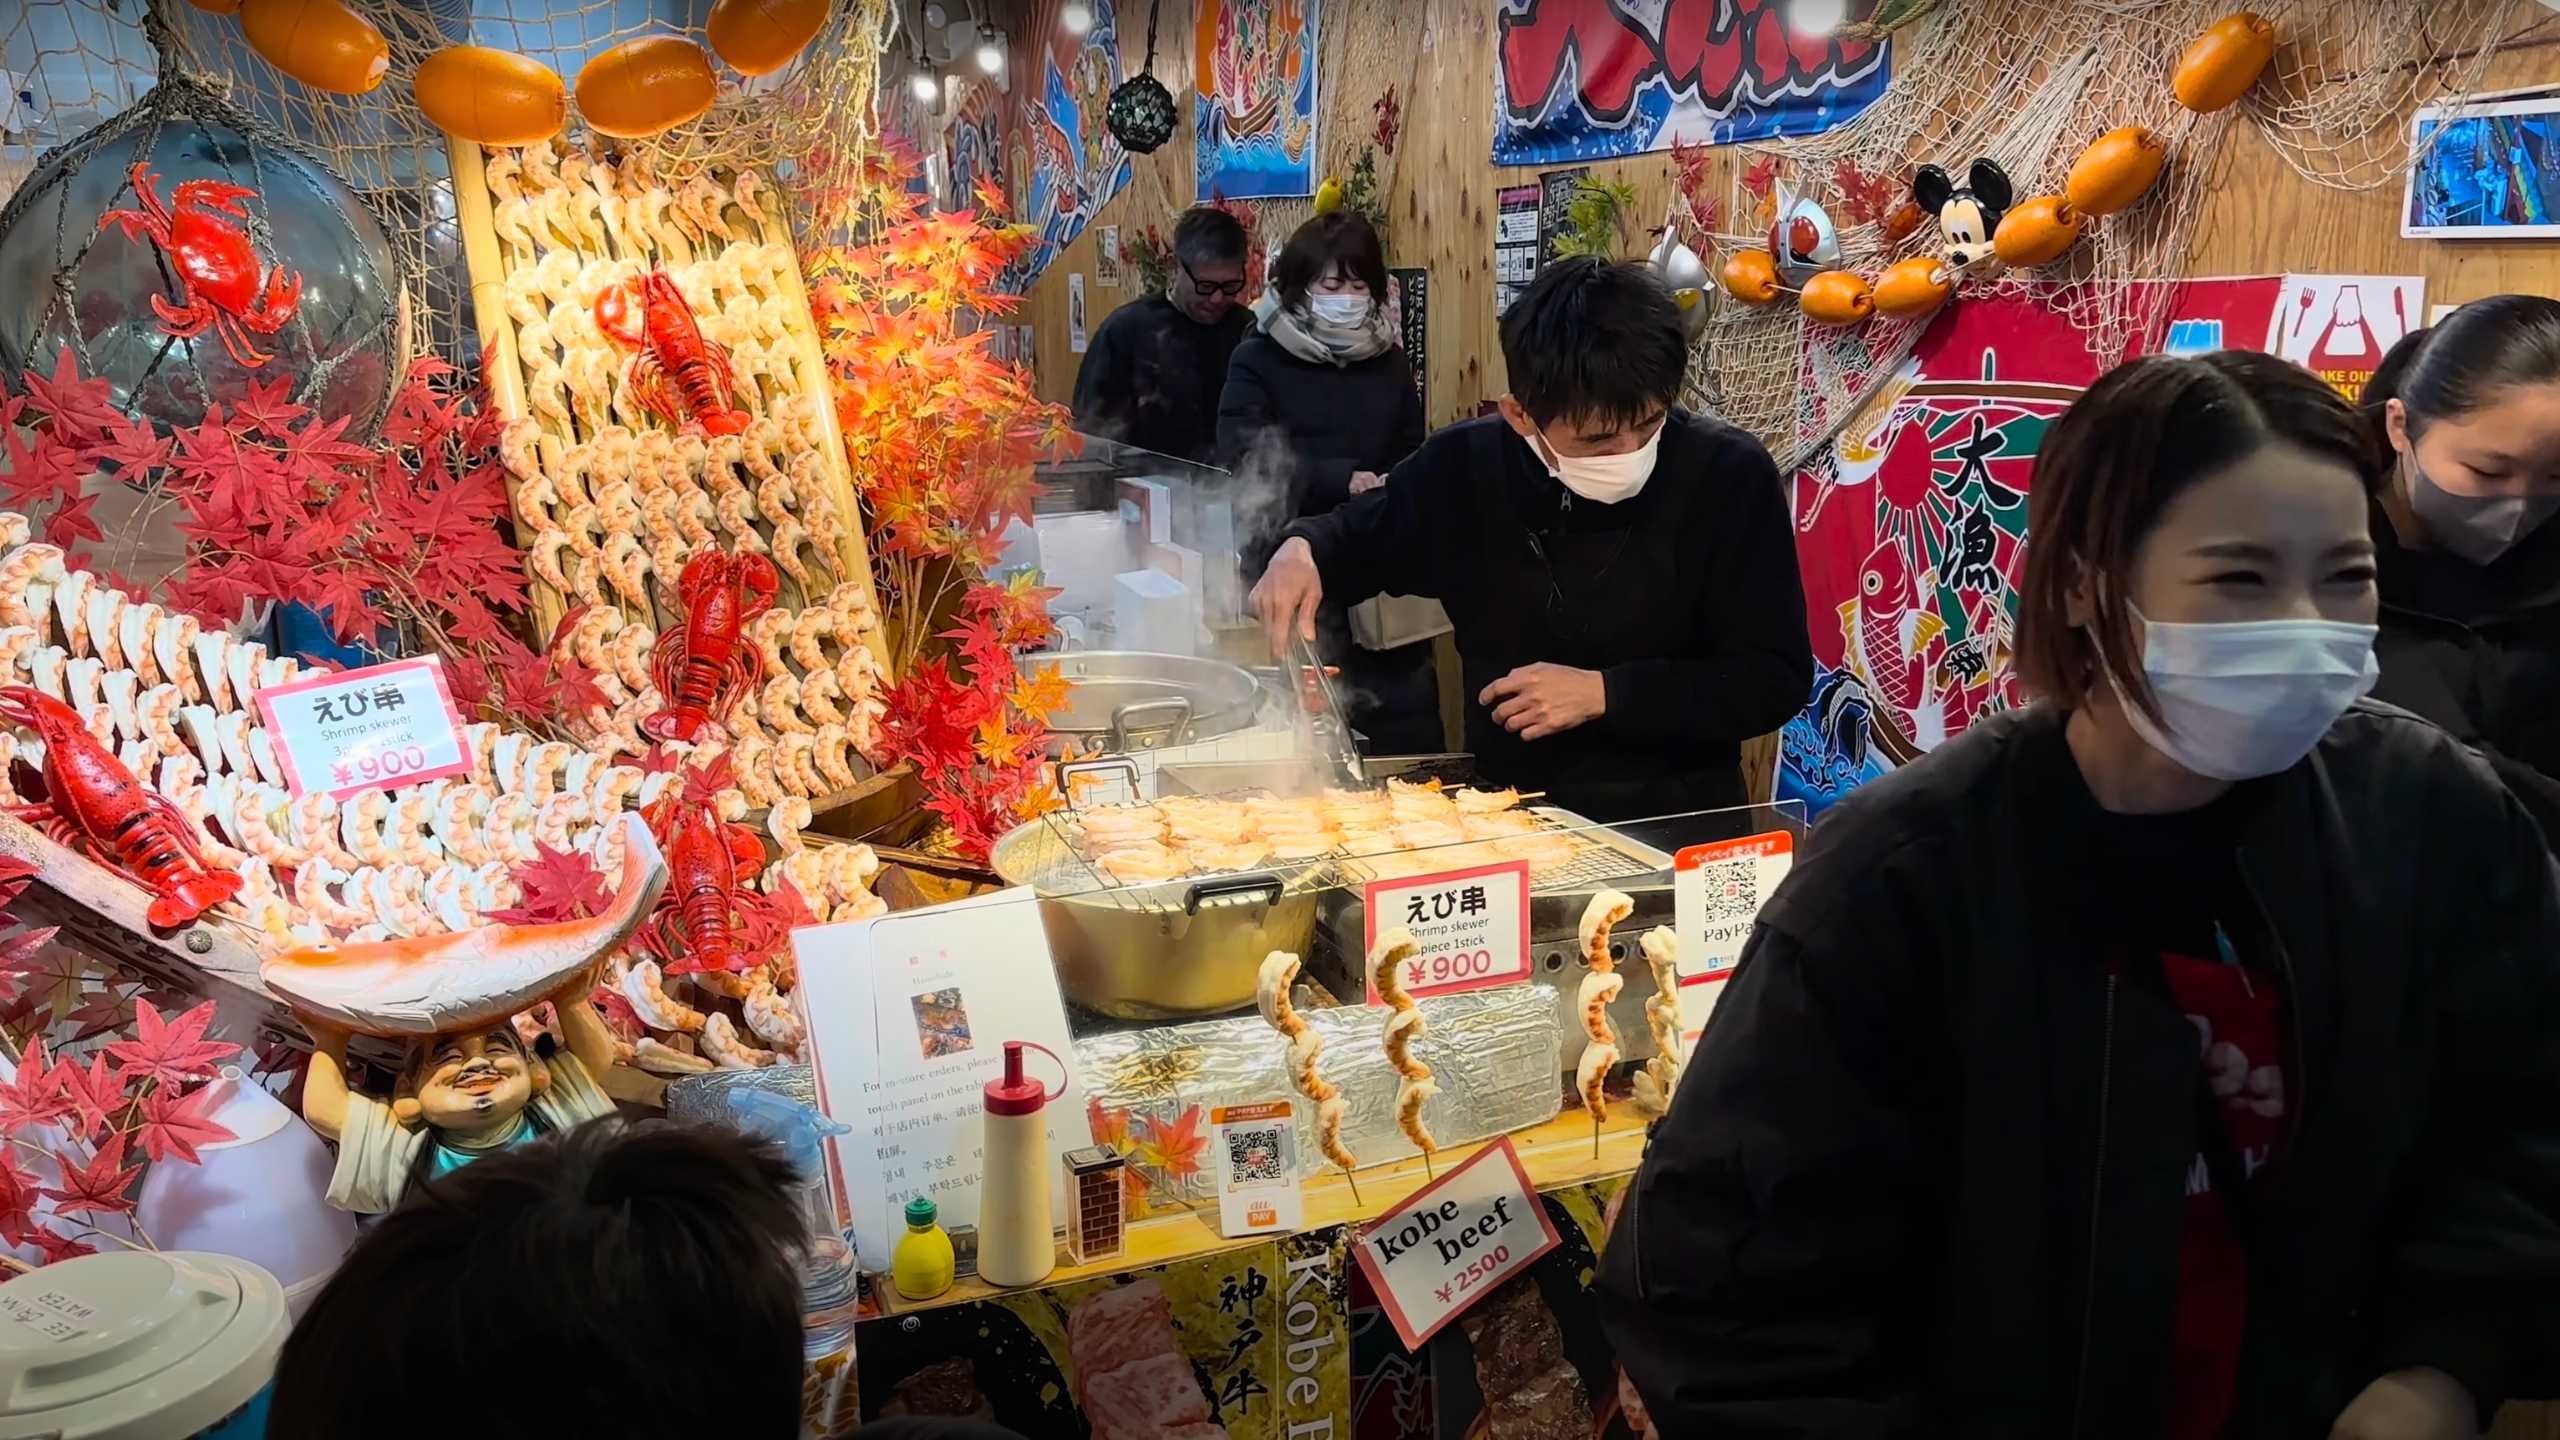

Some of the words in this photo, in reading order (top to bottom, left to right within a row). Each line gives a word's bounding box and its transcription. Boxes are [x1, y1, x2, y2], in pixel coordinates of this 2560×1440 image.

[1416, 276, 1425, 308] Big
[1416, 312, 1425, 365] Steak
[2318, 370, 2346, 382] AKE
[1938, 413, 2024, 594] 大漁
[313, 682, 406, 725] えび串
[321, 723, 368, 742] Shrimp
[369, 714, 413, 732] skewer
[1407, 886, 1487, 924] えび串
[1451, 918, 1490, 932] skewer
[1704, 922, 1753, 942] PayPa
[1420, 940, 1450, 956] piece
[1454, 935, 1486, 949] 1stick
[1408, 950, 1491, 985] ¥900
[863, 1081, 881, 1093] For
[967, 1056, 999, 1071] please
[868, 1101, 898, 1115] touch
[901, 1095, 928, 1112] panel
[931, 1092, 945, 1101] on
[946, 1084, 963, 1097] the
[966, 1078, 987, 1094] tabl
[1374, 1200, 1460, 1265] kobe
[1432, 1196, 1513, 1266] beef
[1434, 1245, 1510, 1303] ¥2500
[1219, 1266, 1268, 1415] 神戸牛
[1285, 1247, 1335, 1407] Kobe
